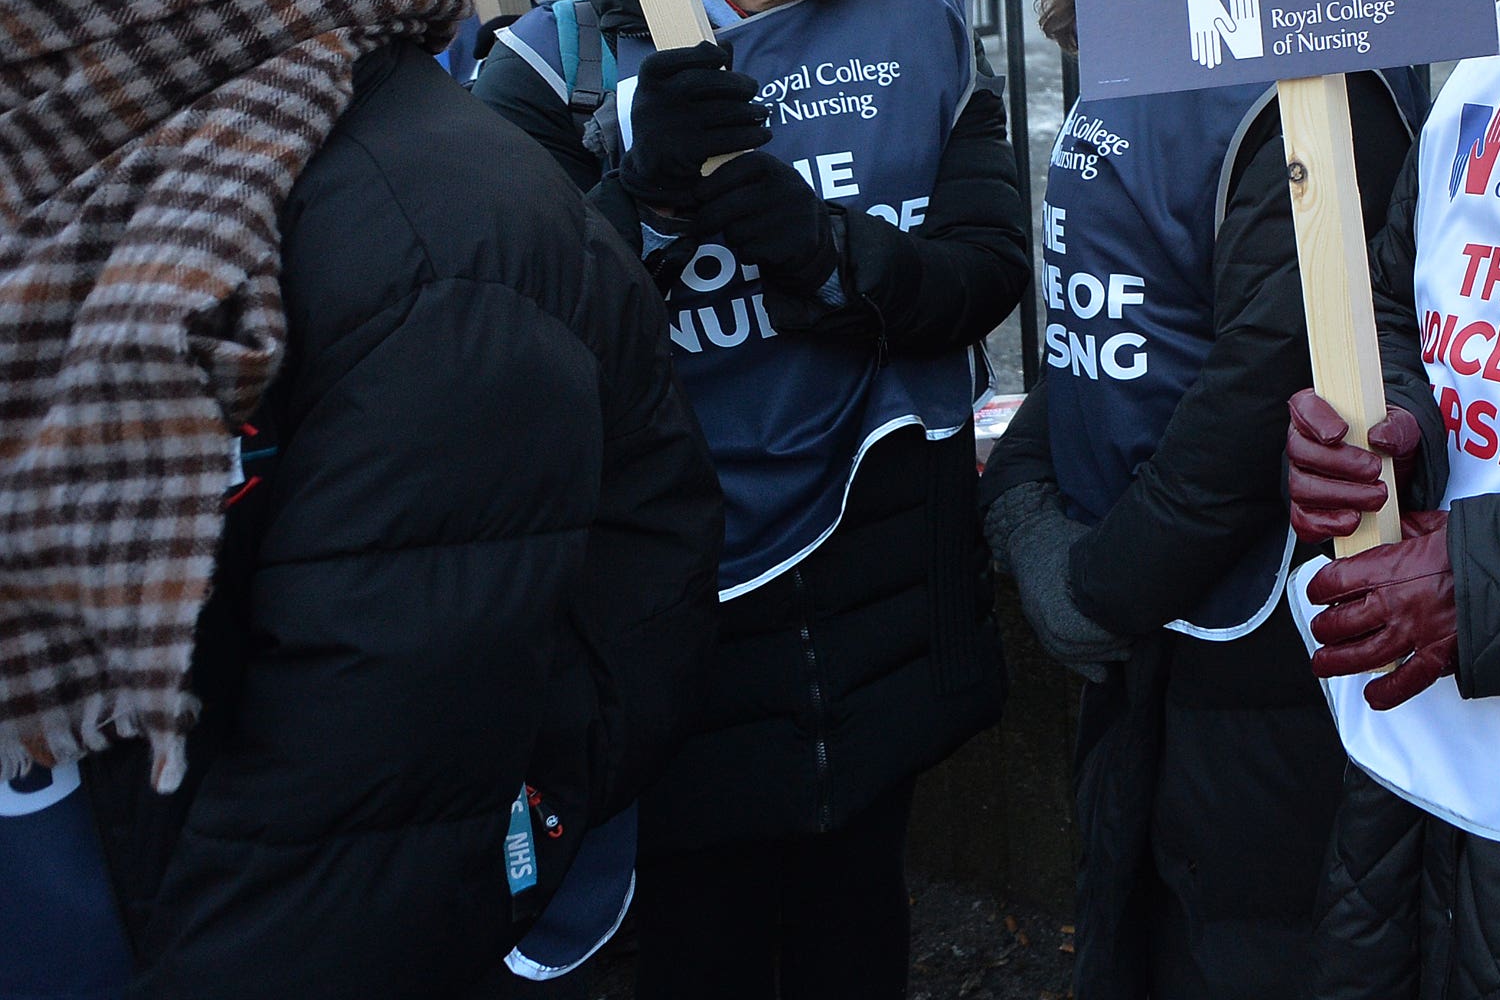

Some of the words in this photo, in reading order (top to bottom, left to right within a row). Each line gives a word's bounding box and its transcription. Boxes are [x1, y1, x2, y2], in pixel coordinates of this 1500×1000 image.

[1271, 2, 1322, 33] Royal
[1273, 33, 1294, 55] of
[1298, 28, 1370, 54] Nursing
[816, 58, 900, 86] College
[779, 91, 878, 124] Nursing
[1073, 115, 1129, 156] College
[1068, 272, 1145, 319] OF
[506, 832, 533, 879] NHS
